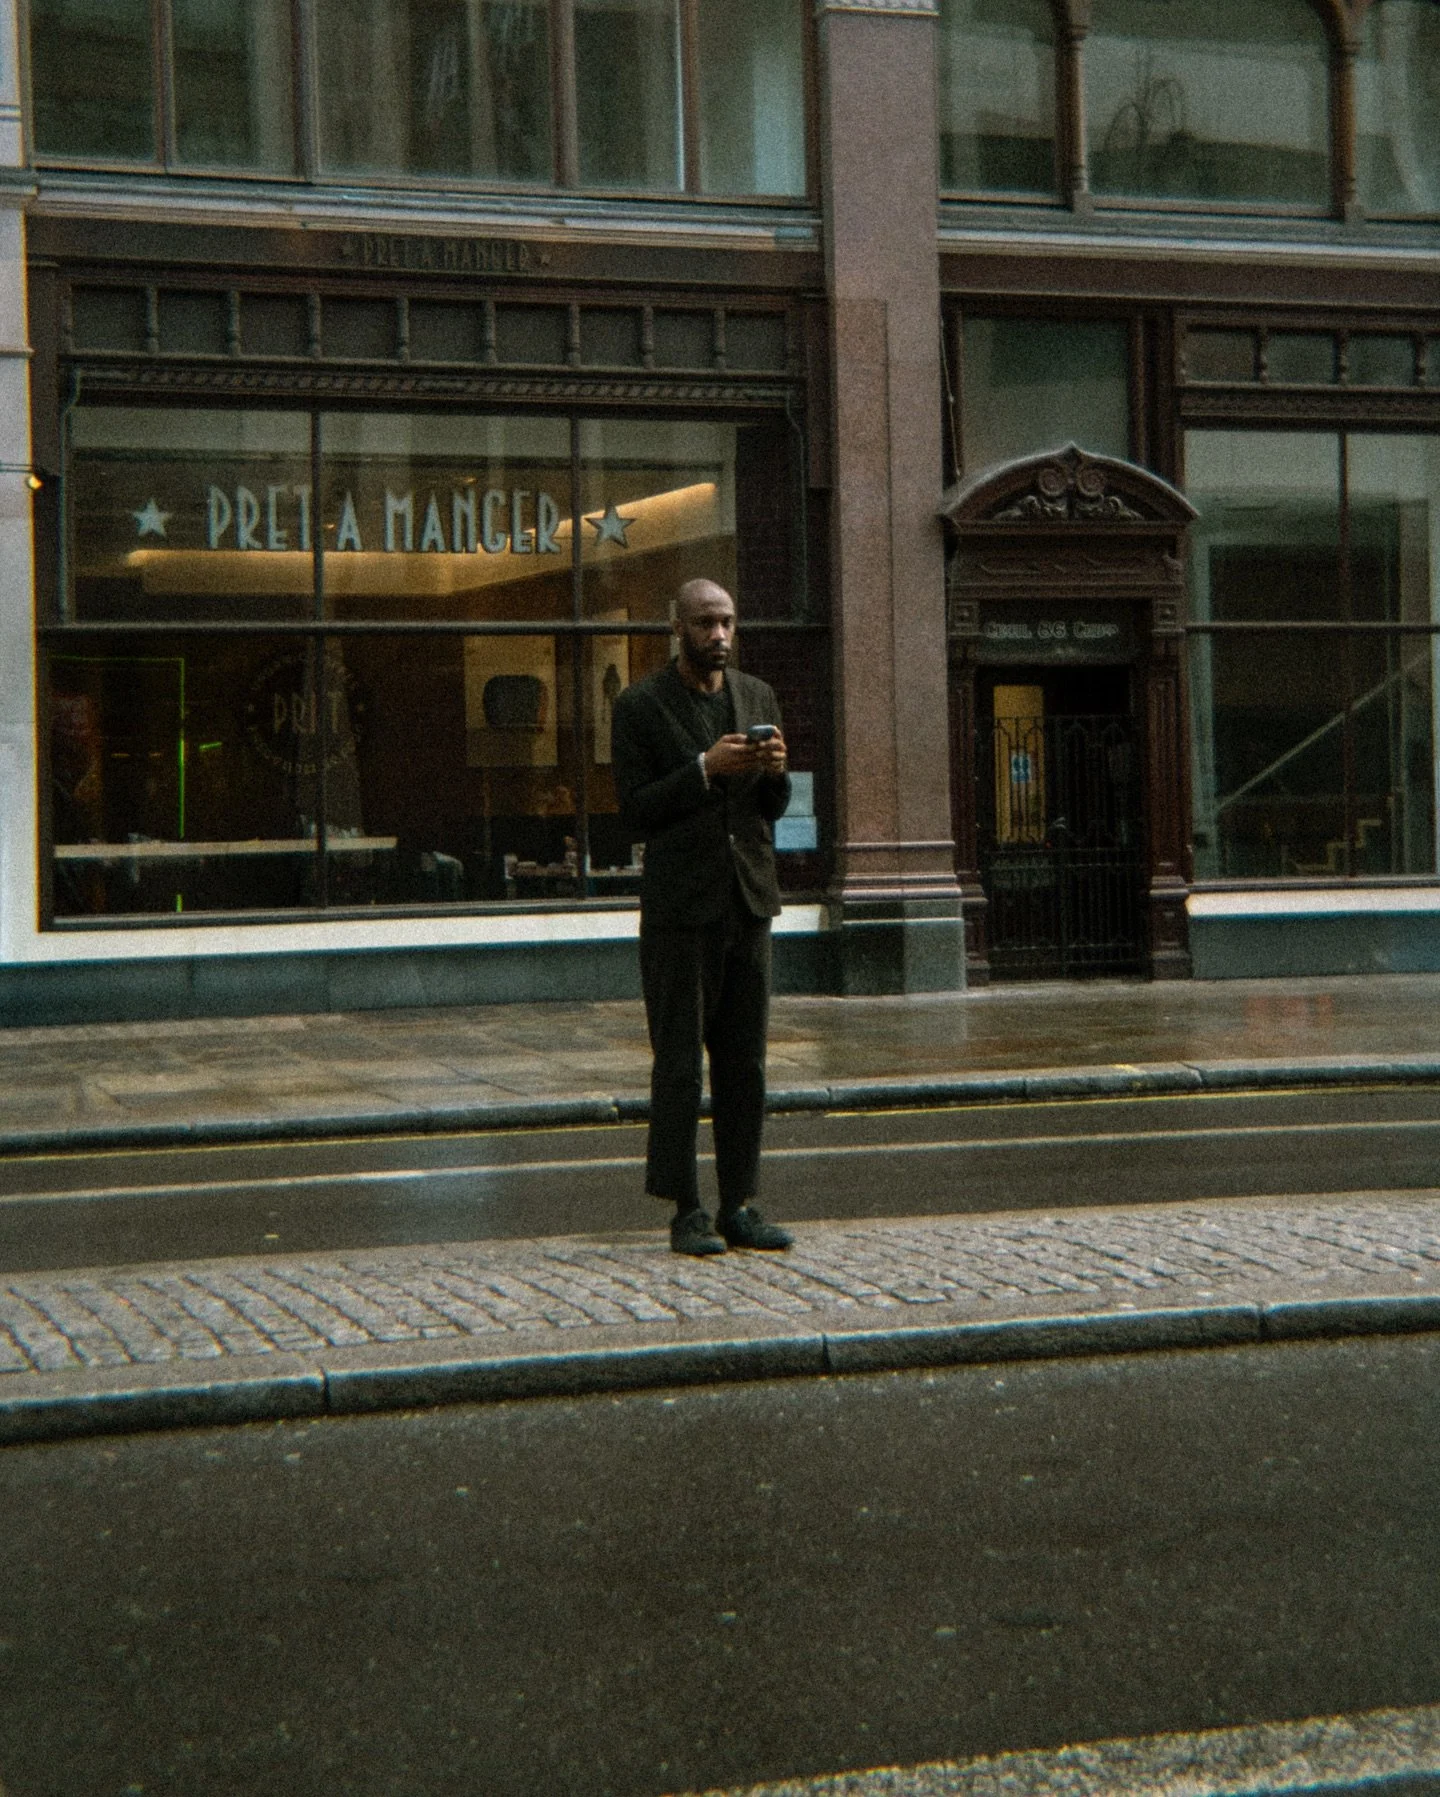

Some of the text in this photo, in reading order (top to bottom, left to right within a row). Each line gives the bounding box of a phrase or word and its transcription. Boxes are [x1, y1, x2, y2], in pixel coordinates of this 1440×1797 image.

[363, 233, 530, 273] PRET A MANGER
[207, 484, 561, 555] PRET A MANGER
